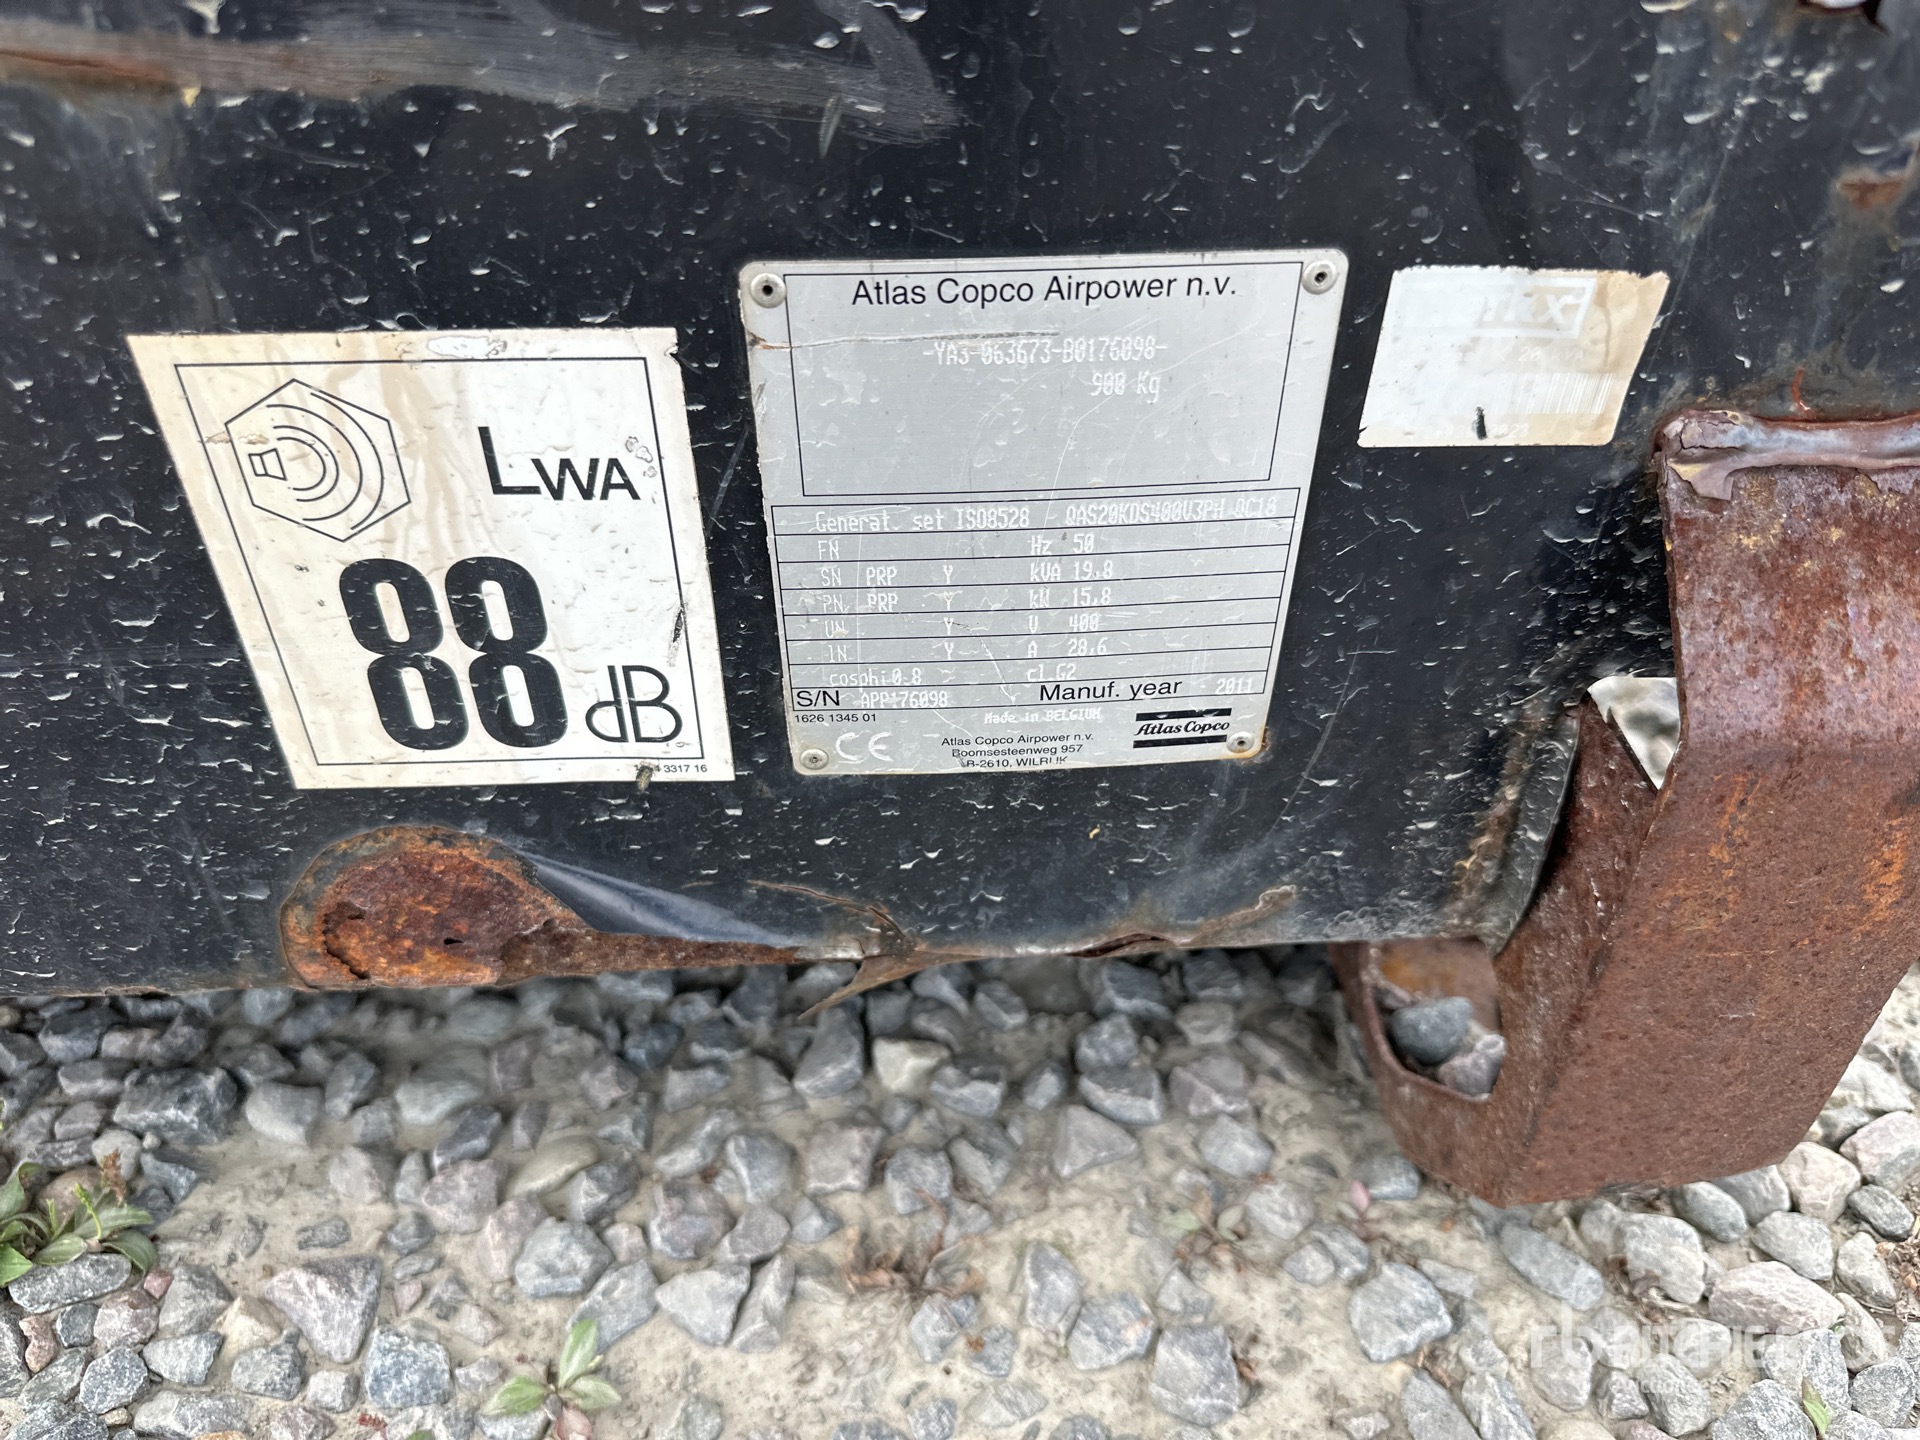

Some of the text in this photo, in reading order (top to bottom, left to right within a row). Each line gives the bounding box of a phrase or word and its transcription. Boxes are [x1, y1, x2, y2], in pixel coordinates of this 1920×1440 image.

[851, 273, 1237, 308] Atlas Copco Airpower n.v.
[1090, 370, 1161, 404] 900 Kg
[912, 508, 945, 531] set
[956, 507, 1030, 530] ISO8528
[818, 534, 1095, 560] FN Hz 50
[821, 567, 841, 587] SN
[866, 565, 897, 587] PRP
[943, 564, 953, 584] Y
[1030, 561, 1061, 582] kVA
[823, 594, 844, 613] PN
[867, 592, 898, 612] PRP
[1069, 613, 1099, 632] 400
[338, 556, 683, 751] 88 dB
[1027, 640, 1038, 658] A
[796, 690, 840, 707] S/N
[1040, 681, 1120, 701] Manuf.
[1129, 680, 1183, 700] year
[1215, 678, 1253, 695] 2011
[794, 713, 877, 723] 1626 1345 01
[984, 707, 1101, 724] Made in BELGIUM
[1134, 720, 1230, 736] Atlas Copco
[836, 731, 894, 762] CE
[941, 733, 1094, 747] Atlas Copco Airpower n.v.
[952, 744, 1083, 757] Boomsesteenweg 957
[663, 764, 690, 773] 3317
[694, 764, 708, 773] 16
